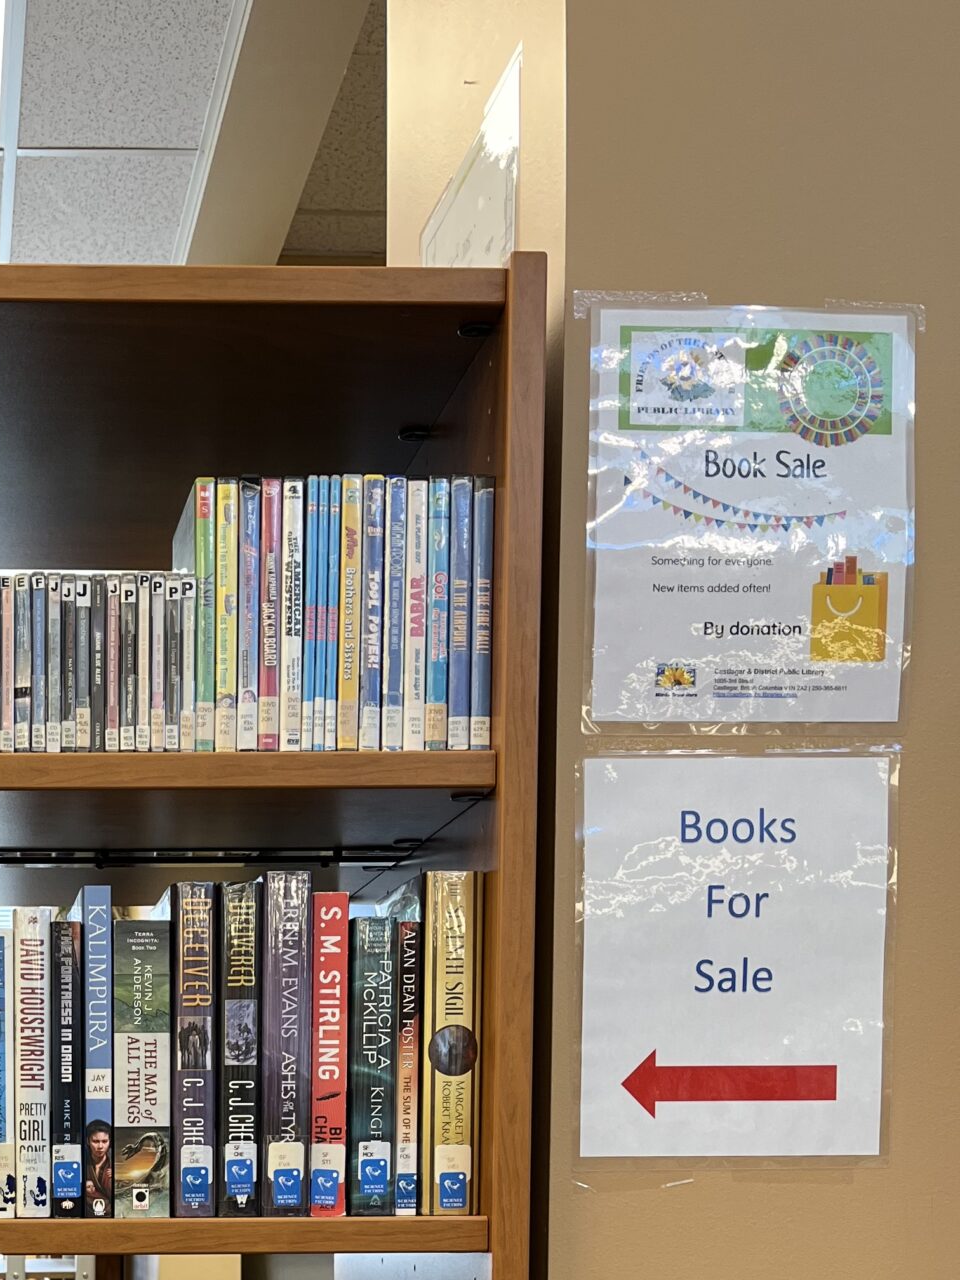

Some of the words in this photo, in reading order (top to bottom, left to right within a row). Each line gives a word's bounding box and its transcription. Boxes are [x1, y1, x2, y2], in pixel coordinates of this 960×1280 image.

[705, 450, 766, 478] Book
[776, 450, 827, 478] Sale
[708, 557, 722, 565] for
[36, 578, 42, 587] F
[77, 584, 87, 596] J
[125, 590, 133, 600] P
[153, 582, 162, 592] P
[182, 582, 193, 596] P
[344, 567, 357, 615] Brothers
[652, 584, 674, 592] New
[678, 584, 704, 592] items
[707, 583, 739, 592] added
[742, 584, 770, 592] often!
[410, 575, 425, 637] BABAR
[344, 618, 355, 638] and
[704, 622, 724, 638] By
[730, 622, 801, 635] donation
[344, 642, 355, 680] Sisters
[680, 808, 797, 843] Books
[707, 885, 769, 918] For
[320, 906, 342, 929] S.
[19, 938, 45, 982] DAVID
[320, 934, 341, 962] M.
[88, 904, 108, 1053] KALIMPURA
[144, 965, 152, 997] KEVIN
[694, 958, 773, 993] Sale
[133, 957, 142, 1026] ANDERSON
[144, 1004, 152, 1015] J.
[318, 970, 341, 1081] STIRLING
[19, 988, 45, 1091] HOUSEWRIGHT
[127, 1035, 139, 1062] ALL
[144, 1039, 157, 1065] THE
[87, 1085, 110, 1094] LAKE
[90, 1073, 106, 1083] JAY
[144, 1070, 157, 1107] MAP
[19, 1102, 47, 1116] PRETTY
[127, 1068, 140, 1124] THINGS
[19, 1119, 47, 1141] GIRL
[143, 1110, 157, 1124] of
